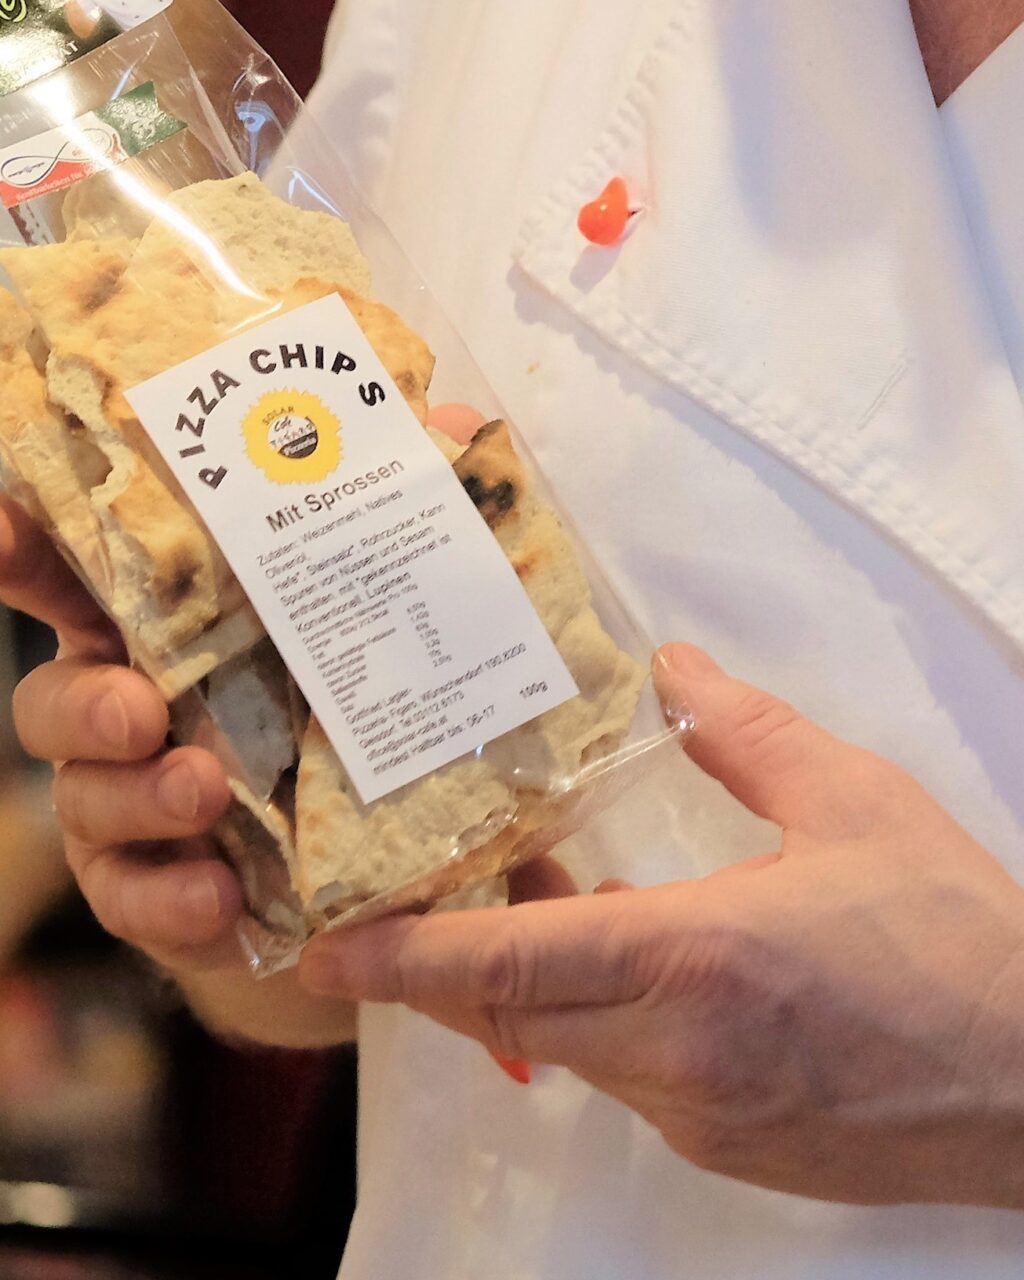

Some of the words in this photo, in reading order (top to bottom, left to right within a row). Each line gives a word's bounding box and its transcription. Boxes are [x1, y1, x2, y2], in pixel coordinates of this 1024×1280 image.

[175, 369, 241, 489] PIZZA
[249, 343, 386, 407] CHIPS
[265, 504, 305, 533] Mit
[303, 460, 404, 513] Sprossen
[418, 503, 446, 521] Kann
[279, 583, 318, 608] Spuren
[319, 573, 338, 588] von
[378, 540, 400, 558] und
[398, 526, 434, 548] Sesam
[338, 580, 356, 597] mit
[365, 571, 412, 600] Lupinen
[519, 680, 549, 699] 100g
